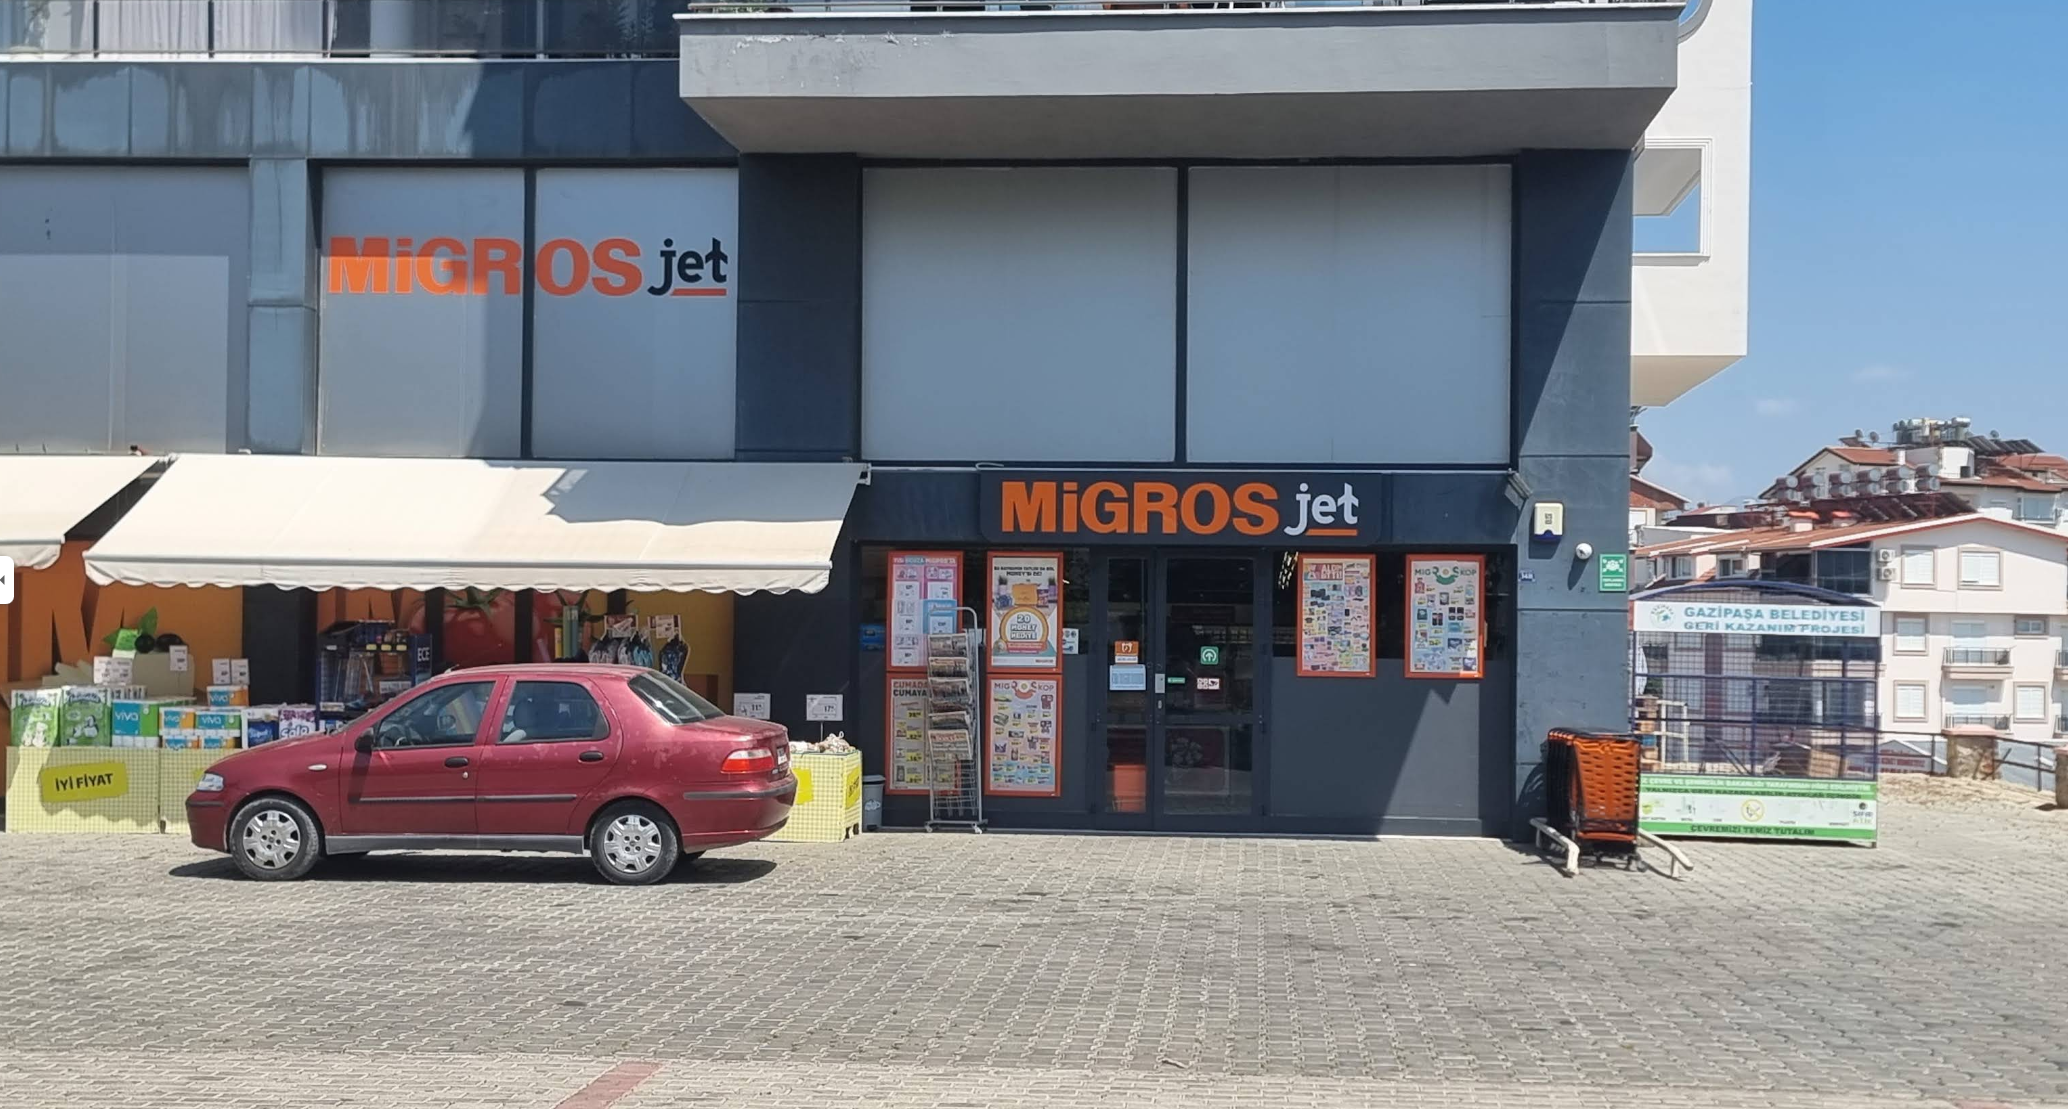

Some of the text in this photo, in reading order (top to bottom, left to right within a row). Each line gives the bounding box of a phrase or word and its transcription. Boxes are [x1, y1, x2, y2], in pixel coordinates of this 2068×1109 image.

[647, 237, 730, 297] jet
[1283, 482, 1360, 536] jet
[1016, 614, 1031, 624] 20
[1683, 606, 1764, 621] GAZİPAŞA
[1769, 608, 1866, 622] BELEDİYESİ
[1684, 621, 1720, 631] GERİ
[115, 711, 139, 721] viva
[76, 773, 114, 788] FİYAT
